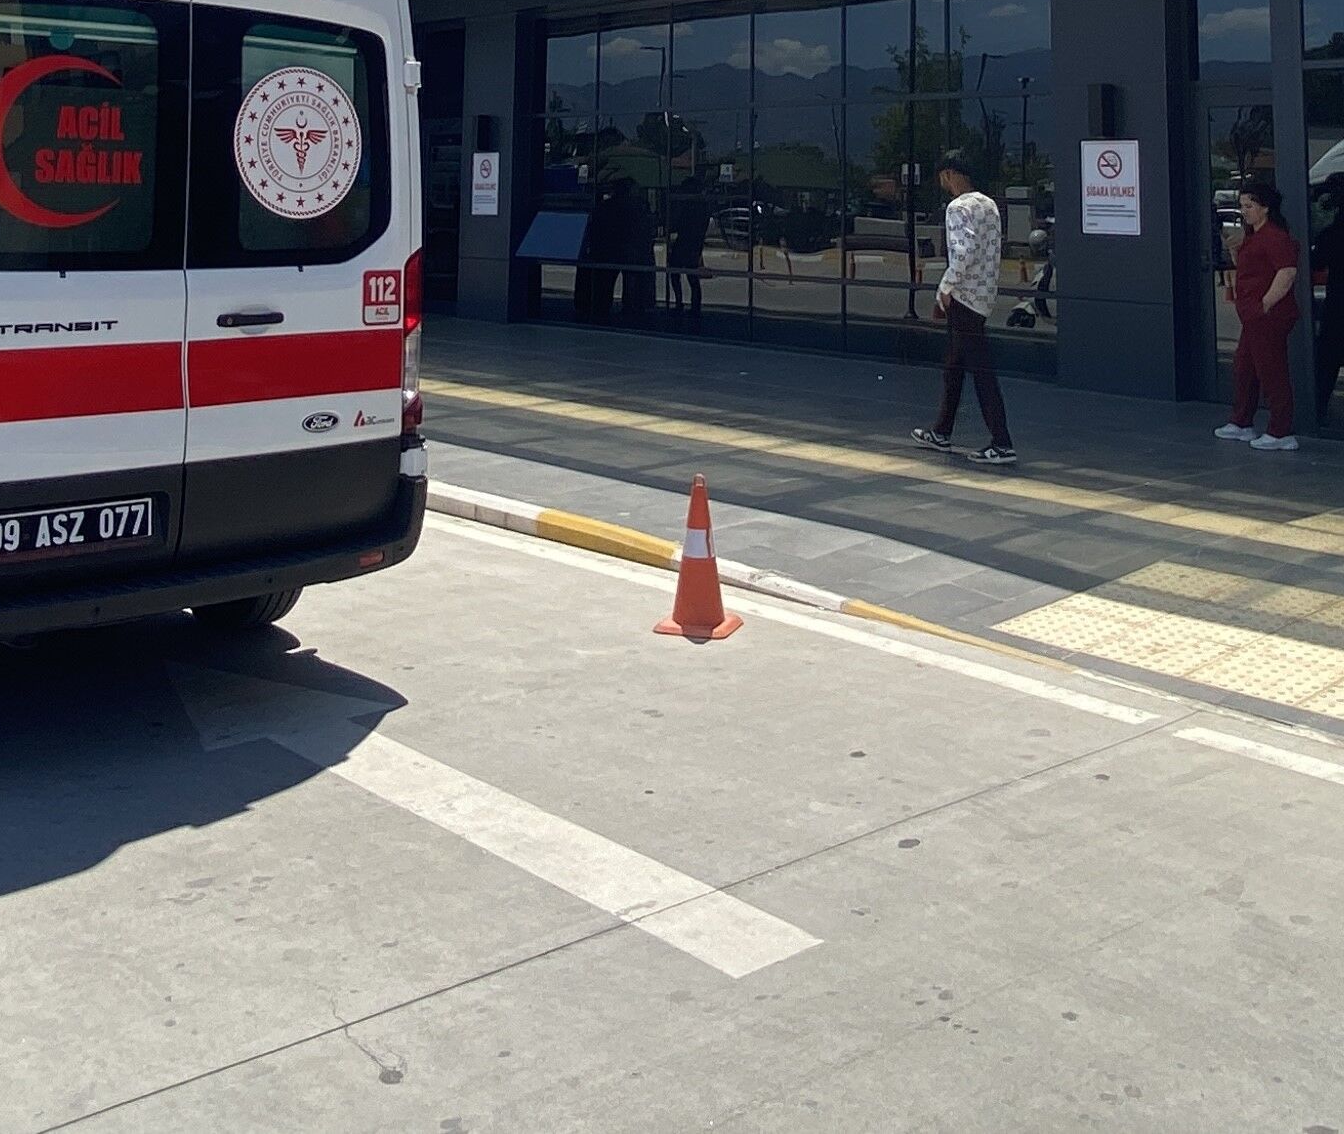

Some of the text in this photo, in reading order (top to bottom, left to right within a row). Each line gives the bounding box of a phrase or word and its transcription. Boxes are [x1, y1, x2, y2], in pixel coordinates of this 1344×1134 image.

[57, 102, 125, 140] ACİL
[35, 142, 143, 184] SAĞLIK
[369, 276, 396, 302] 112
[35, 511, 85, 548] ASZ
[99, 504, 145, 539] 077
